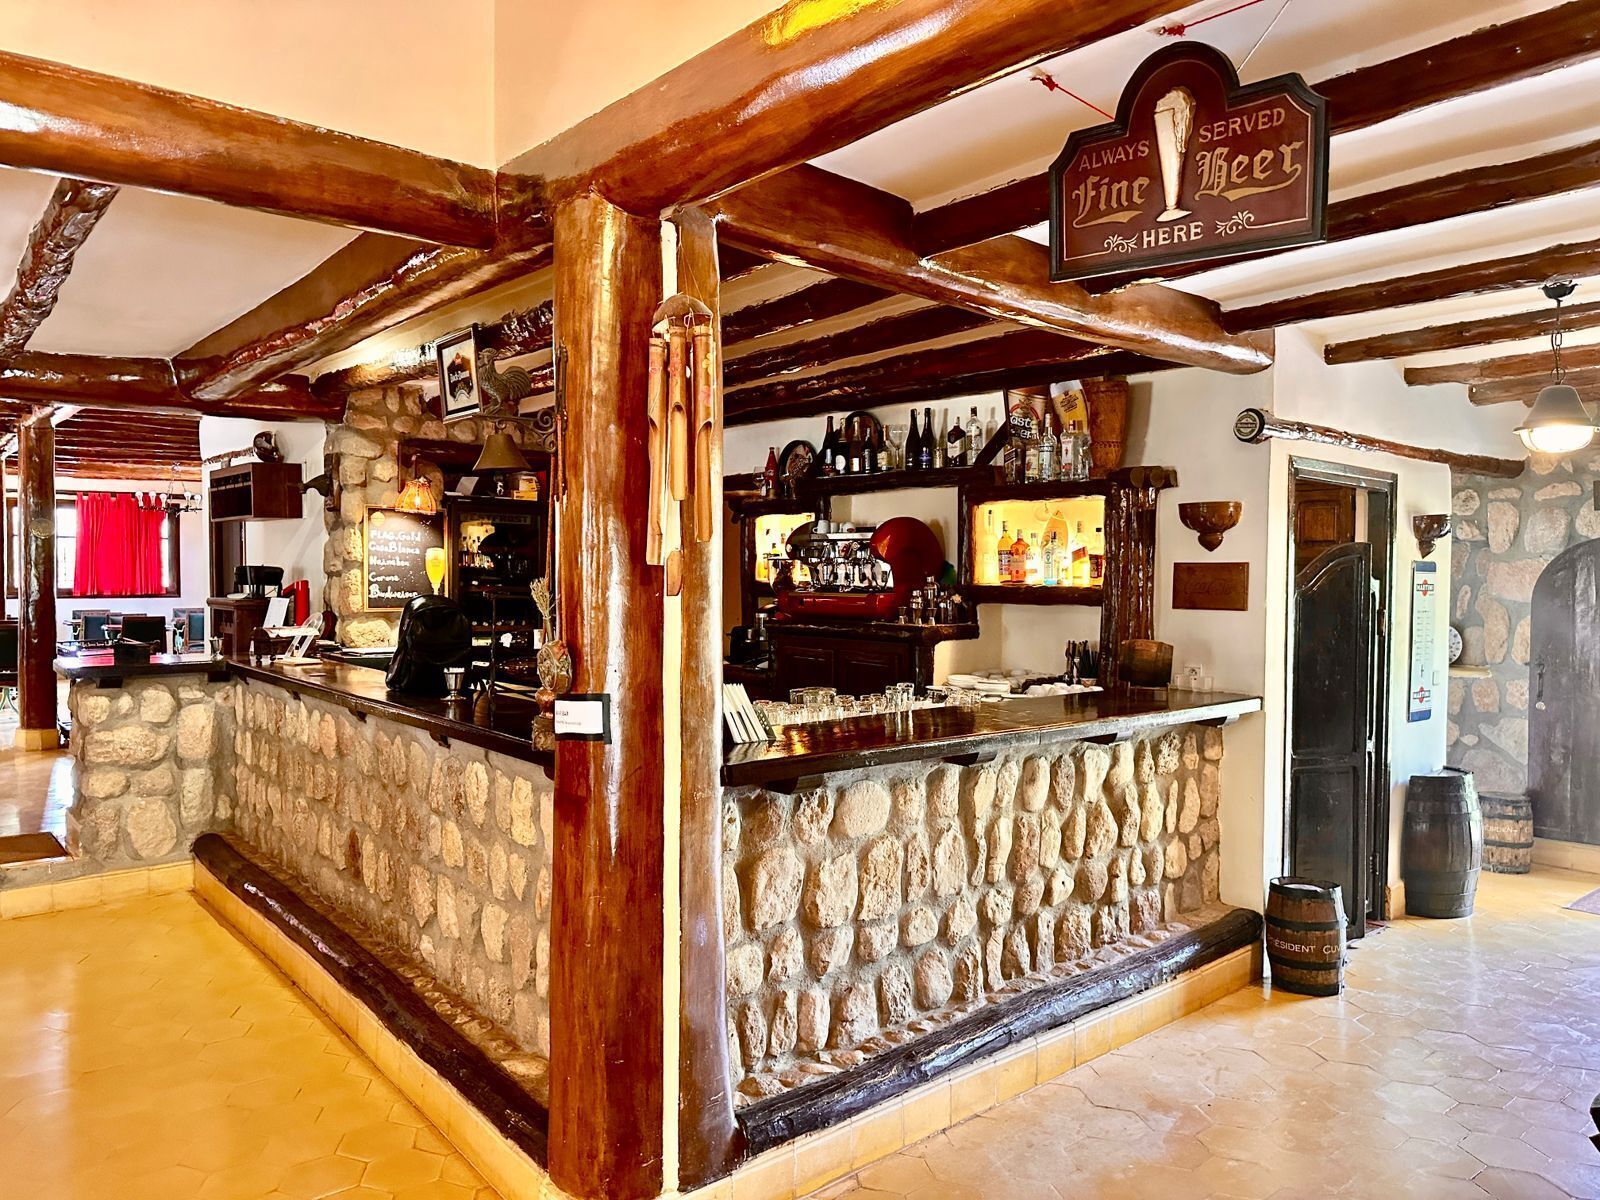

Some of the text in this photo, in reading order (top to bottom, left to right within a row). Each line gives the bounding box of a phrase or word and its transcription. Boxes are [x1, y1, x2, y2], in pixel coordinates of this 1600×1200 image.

[1078, 106, 1286, 172] ALWAYS SERVED
[1071, 140, 1305, 226] Fine Beer
[1142, 221, 1204, 249] HERE
[1273, 938, 1342, 955] ESIDENT CUV
